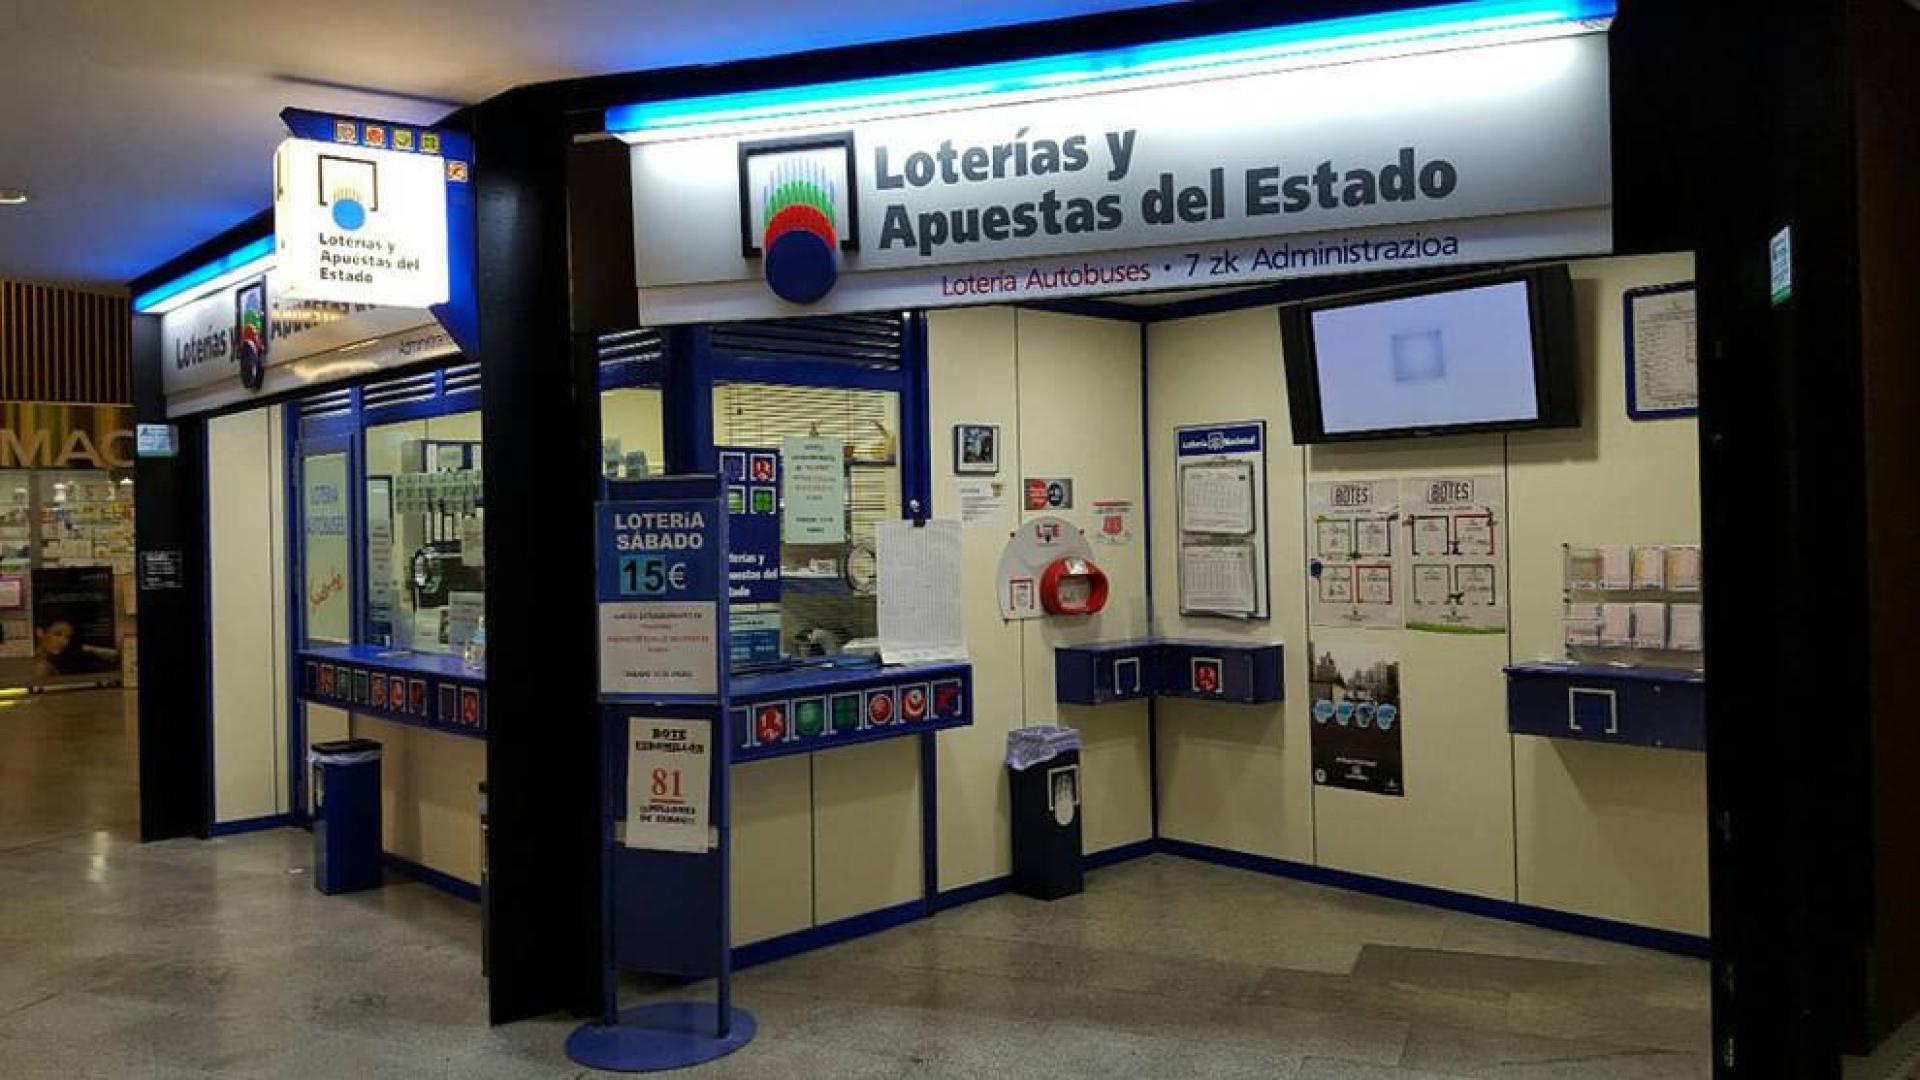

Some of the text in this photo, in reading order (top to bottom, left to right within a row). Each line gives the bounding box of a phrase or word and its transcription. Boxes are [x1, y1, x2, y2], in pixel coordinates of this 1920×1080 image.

[875, 127, 1137, 190] Loterías y
[879, 146, 1458, 256] Apuestas del Estado
[387, 240, 396, 253] y
[320, 250, 420, 271] Apuestas del
[1025, 262, 1151, 290] Autobuses
[1184, 253, 1201, 277] 7
[1209, 248, 1240, 275] zk
[1251, 233, 1460, 272] Administrazioa
[319, 267, 373, 284] Estado
[1335, 487, 1369, 503] BOTES
[1430, 481, 1469, 501] BOTES
[616, 530, 703, 550] SÁBADO
[652, 728, 688, 741] BOTE
[651, 768, 683, 797] 81
